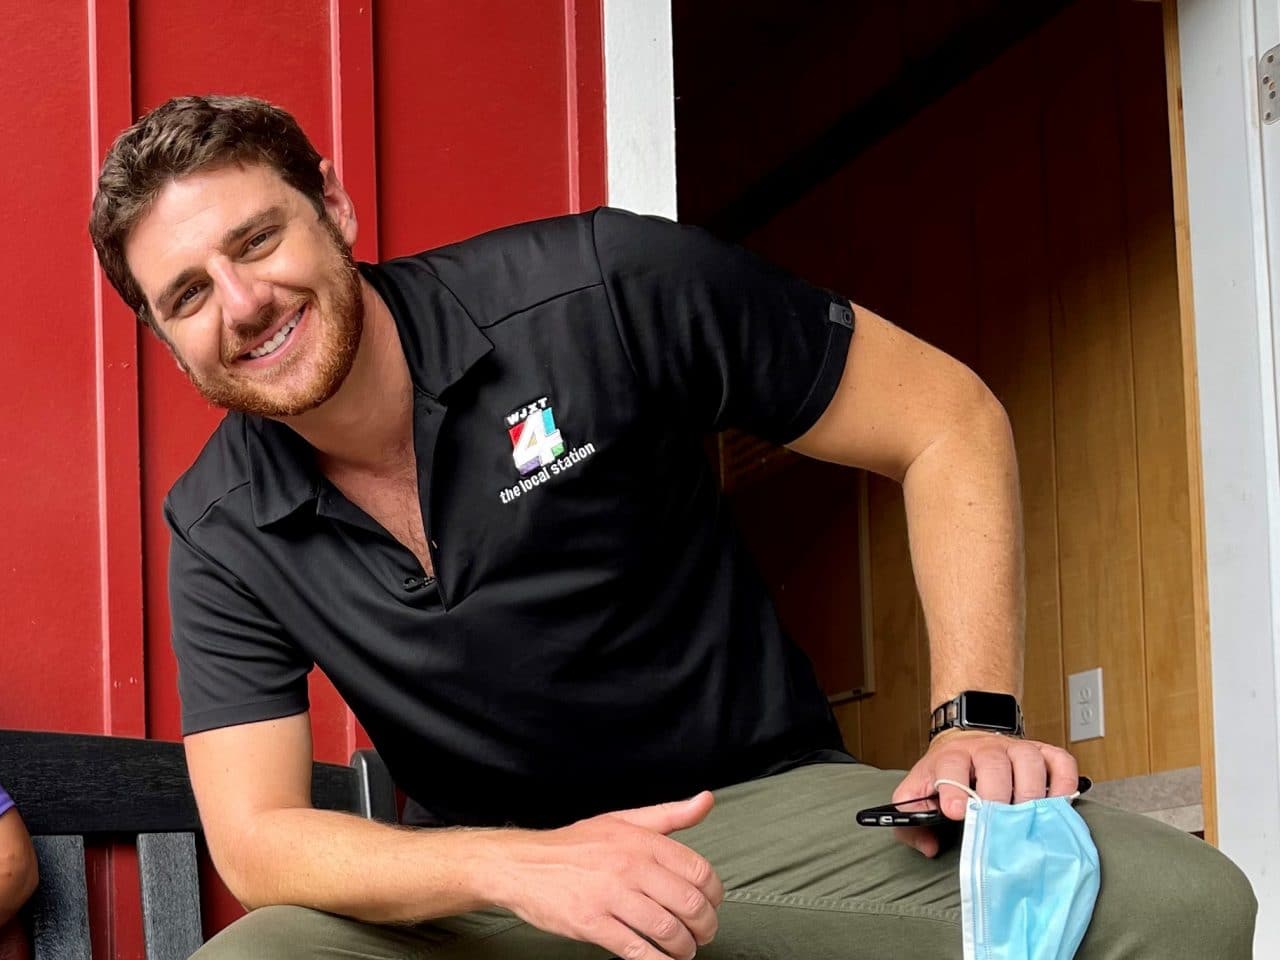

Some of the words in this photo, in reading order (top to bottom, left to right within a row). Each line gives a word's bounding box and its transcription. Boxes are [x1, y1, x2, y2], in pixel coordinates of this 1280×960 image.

[506, 397, 548, 426] WJXT
[512, 407, 564, 471] 4
[499, 484, 521, 504] the
[518, 466, 551, 493] local
[550, 442, 596, 475] station
